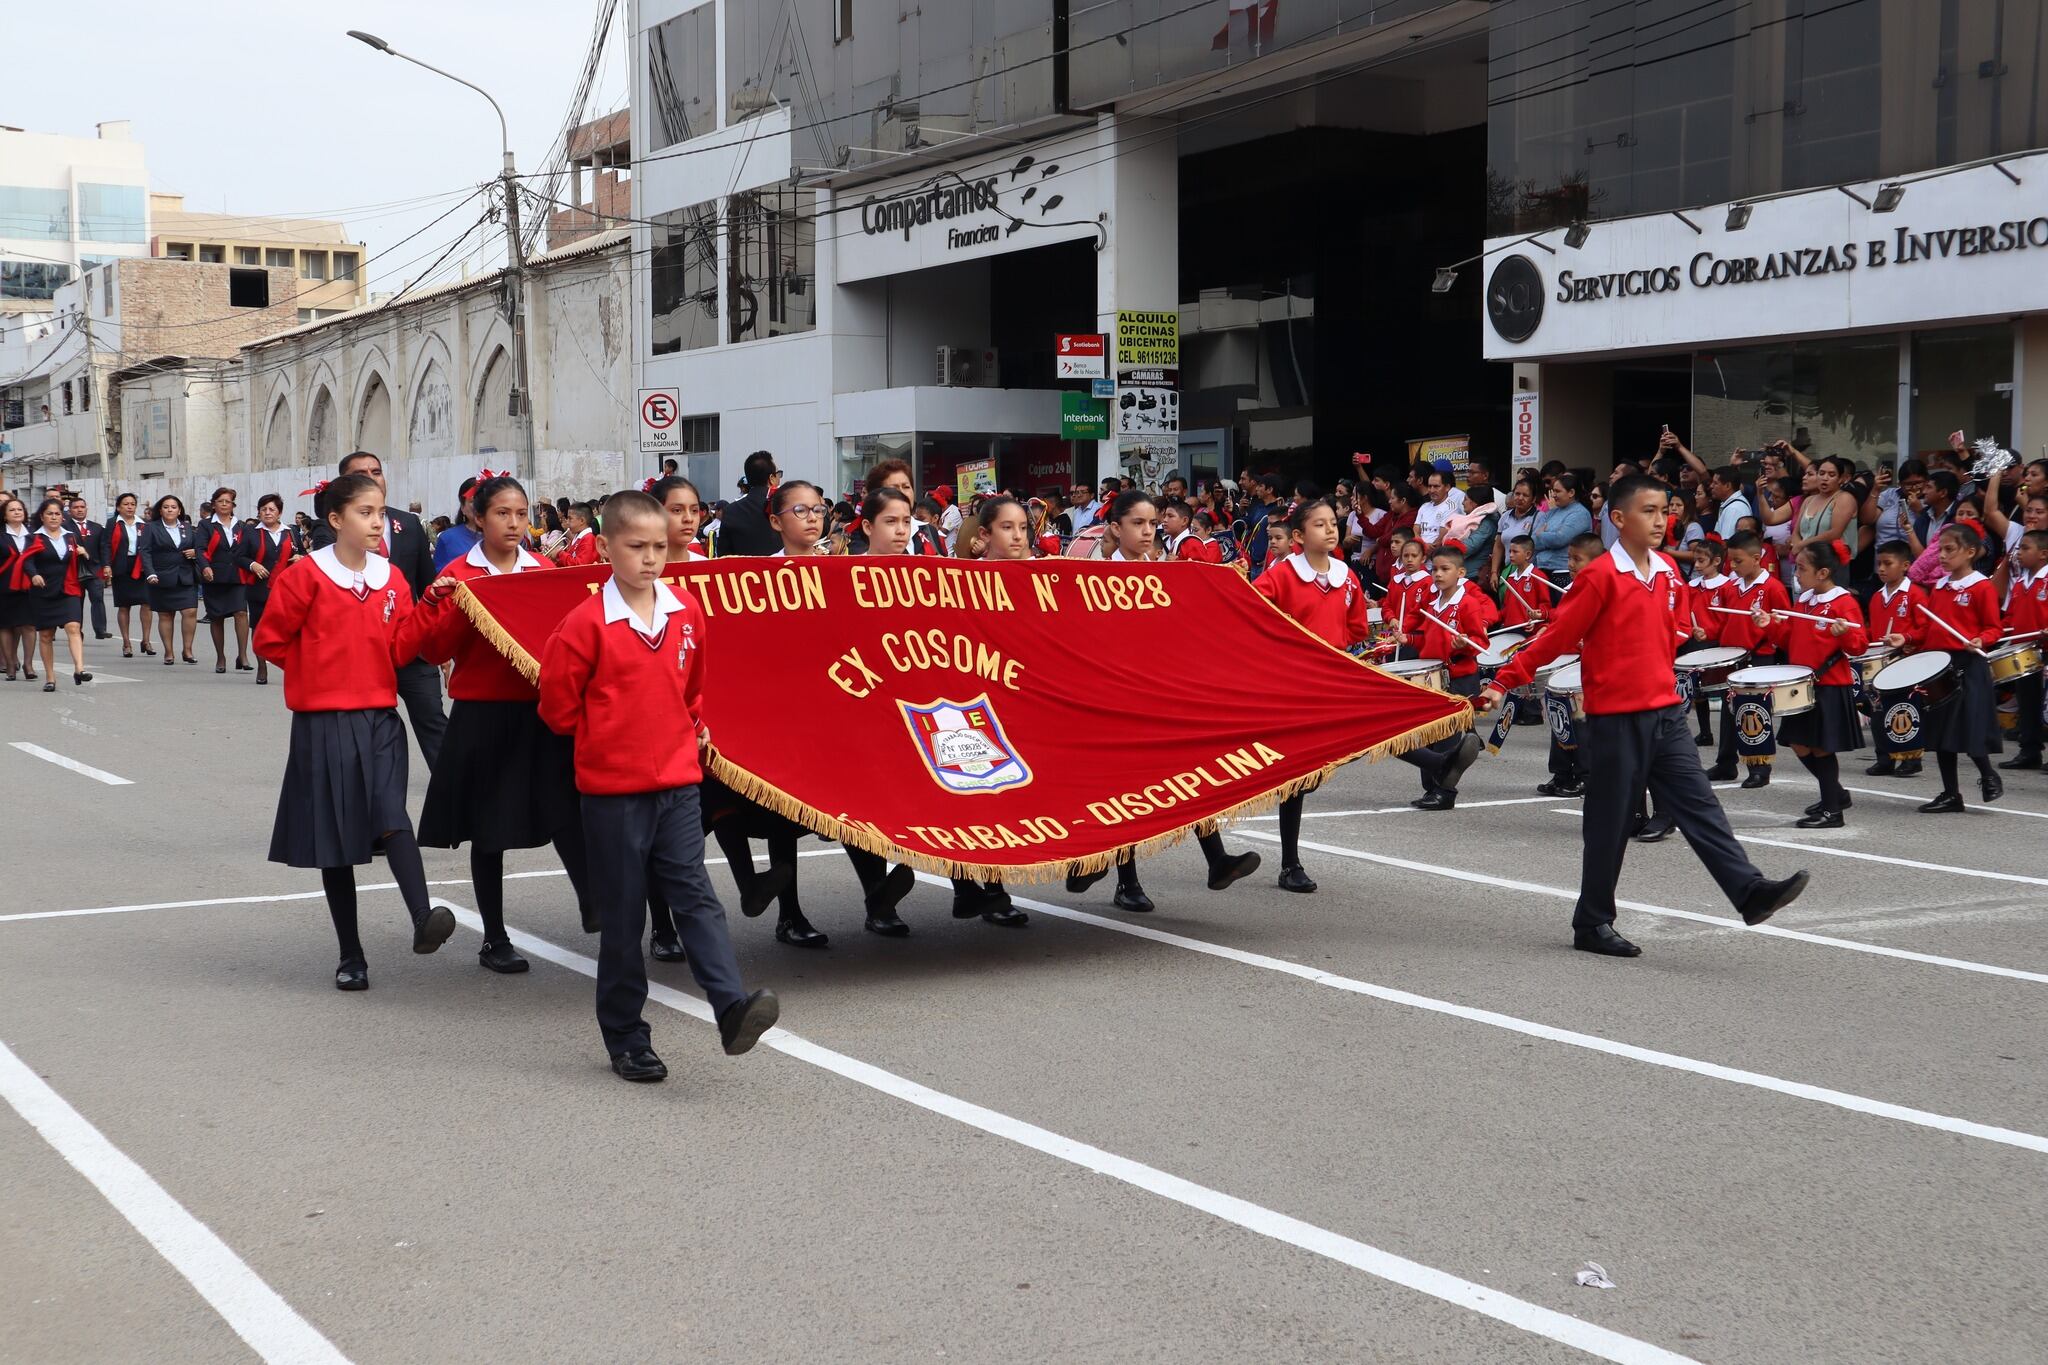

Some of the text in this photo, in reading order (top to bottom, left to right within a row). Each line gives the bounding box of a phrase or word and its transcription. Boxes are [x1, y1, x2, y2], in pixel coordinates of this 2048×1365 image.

[862, 177, 999, 241] Compartamos
[948, 224, 999, 250] Financiera
[1556, 265, 1681, 303] SERVICIOS
[1689, 242, 1858, 288] COBRANZAS
[1867, 239, 1887, 267] E
[1118, 313, 1177, 324] ALQUILO
[1120, 325, 1175, 336] OFICINAS
[1119, 337, 1176, 348] UBICENTRO
[1118, 351, 1135, 364] CEL.
[1064, 413, 1104, 423] Interbank
[1519, 401, 1532, 456] TOURS
[643, 440, 679, 448] ESTACIONAR
[964, 461, 989, 472] TOURS
[1028, 461, 1053, 478] Cajero
[1055, 462, 1065, 474] 24
[850, 565, 1015, 611] EDUCATIVA
[1031, 573, 1059, 612] N°
[1076, 573, 1172, 612] 10828
[827, 628, 1025, 698] EX COSOME
[968, 711, 986, 727] E
[958, 743, 982, 752] 10828
[906, 816, 1069, 851] TRABAJO
[1086, 741, 1285, 826] DISCIPLINA
